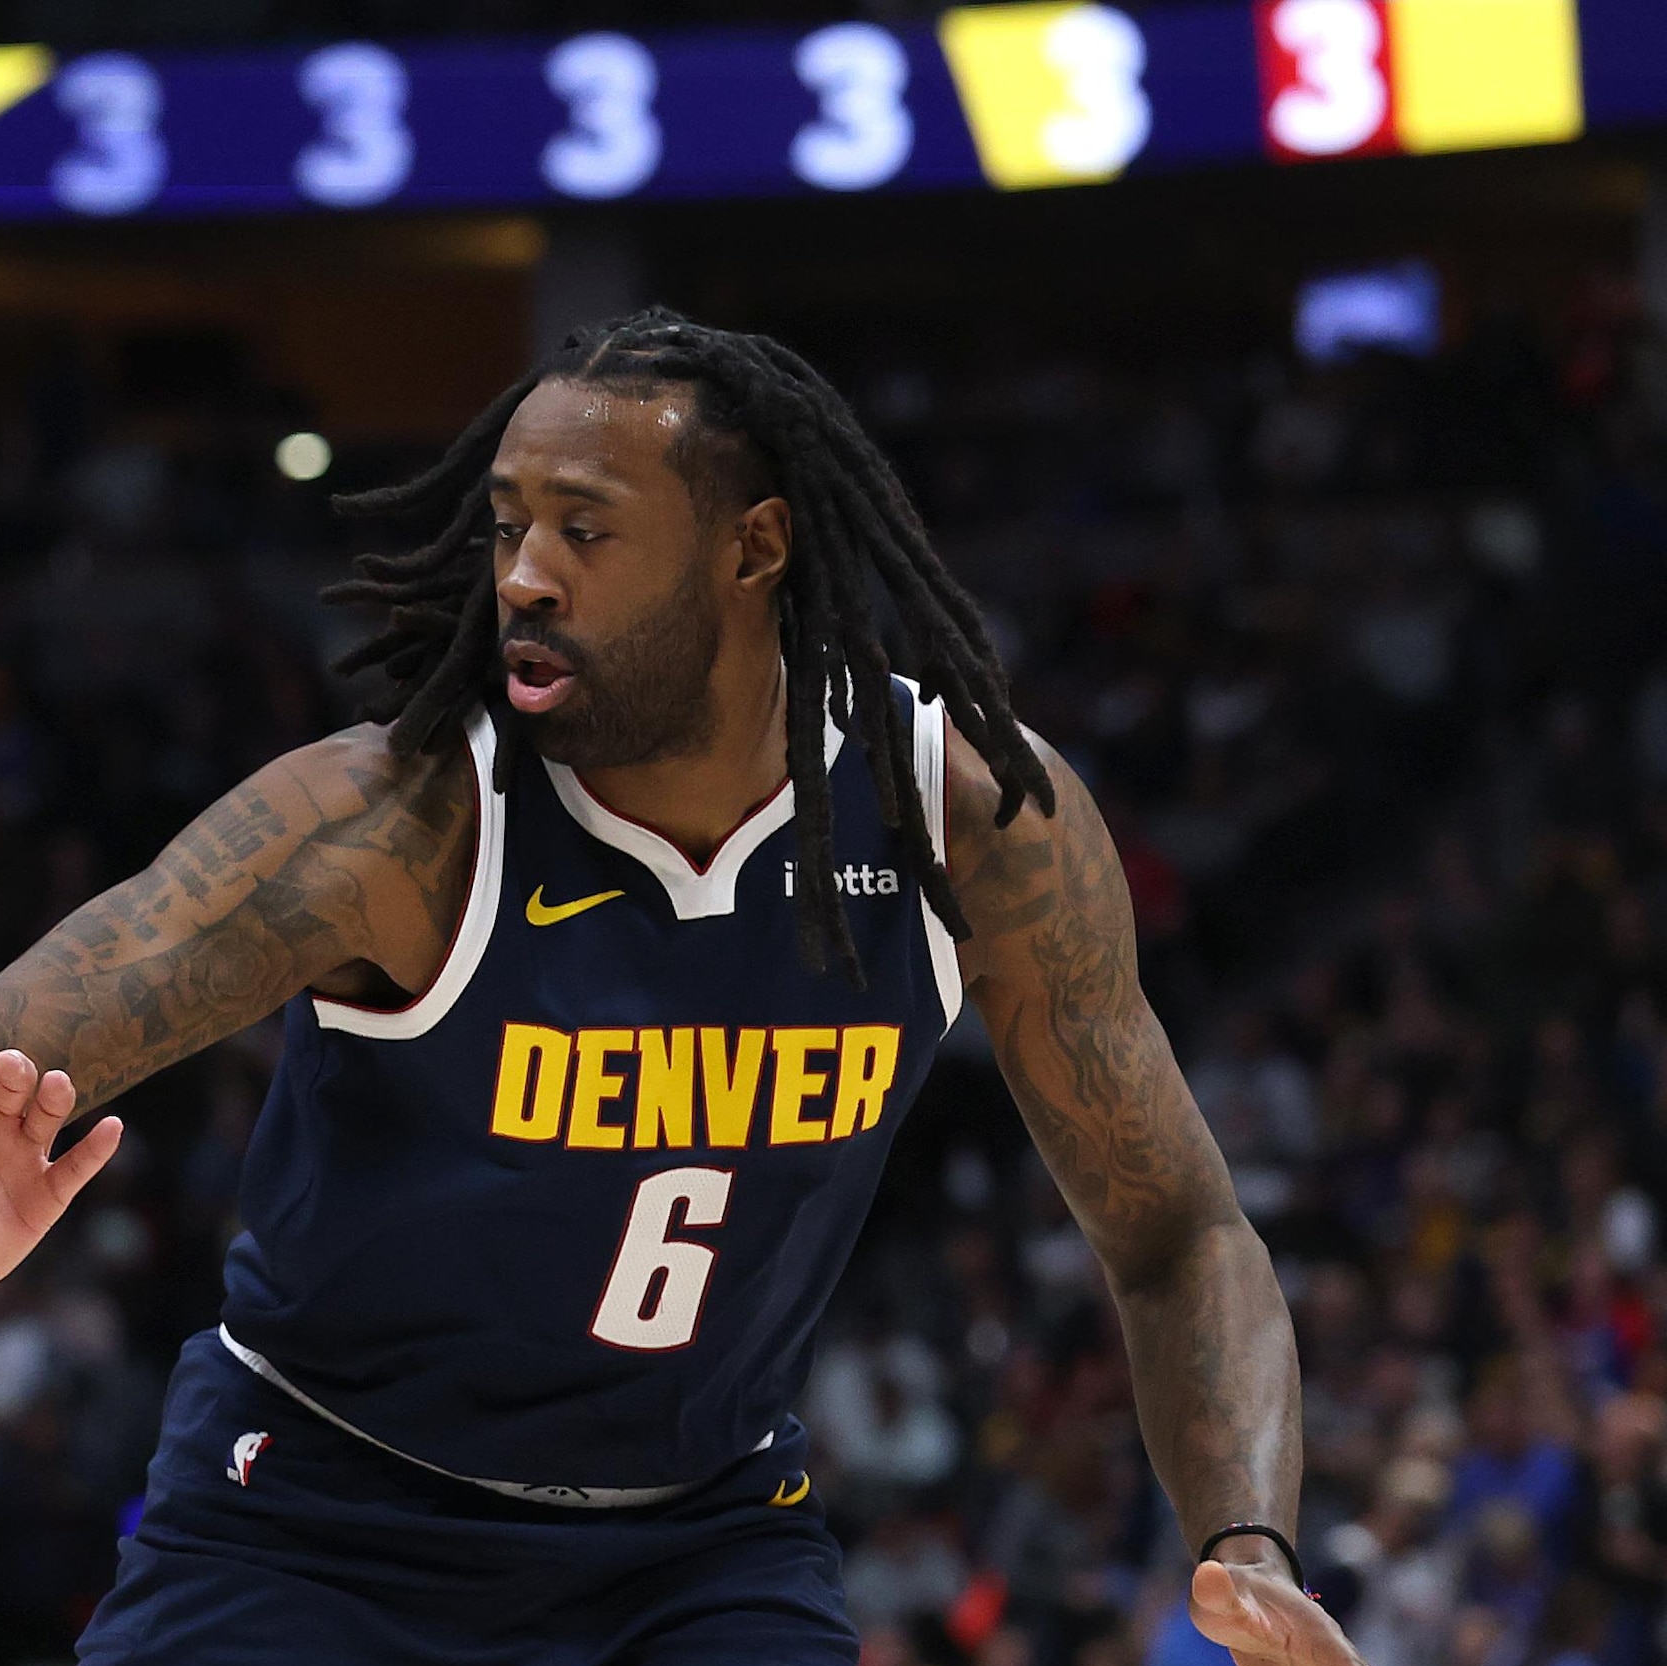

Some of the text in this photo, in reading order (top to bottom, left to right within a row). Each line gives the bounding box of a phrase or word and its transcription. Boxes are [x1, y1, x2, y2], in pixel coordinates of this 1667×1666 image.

[47, 49, 168, 215] 3
[294, 41, 415, 210] 3
[538, 30, 662, 199] 3
[787, 20, 913, 191] 3
[1041, 2, 1151, 175] 3
[1267, 0, 1388, 156] 3
[488, 1021, 903, 1150] DENVER
[587, 1166, 736, 1352] 6
